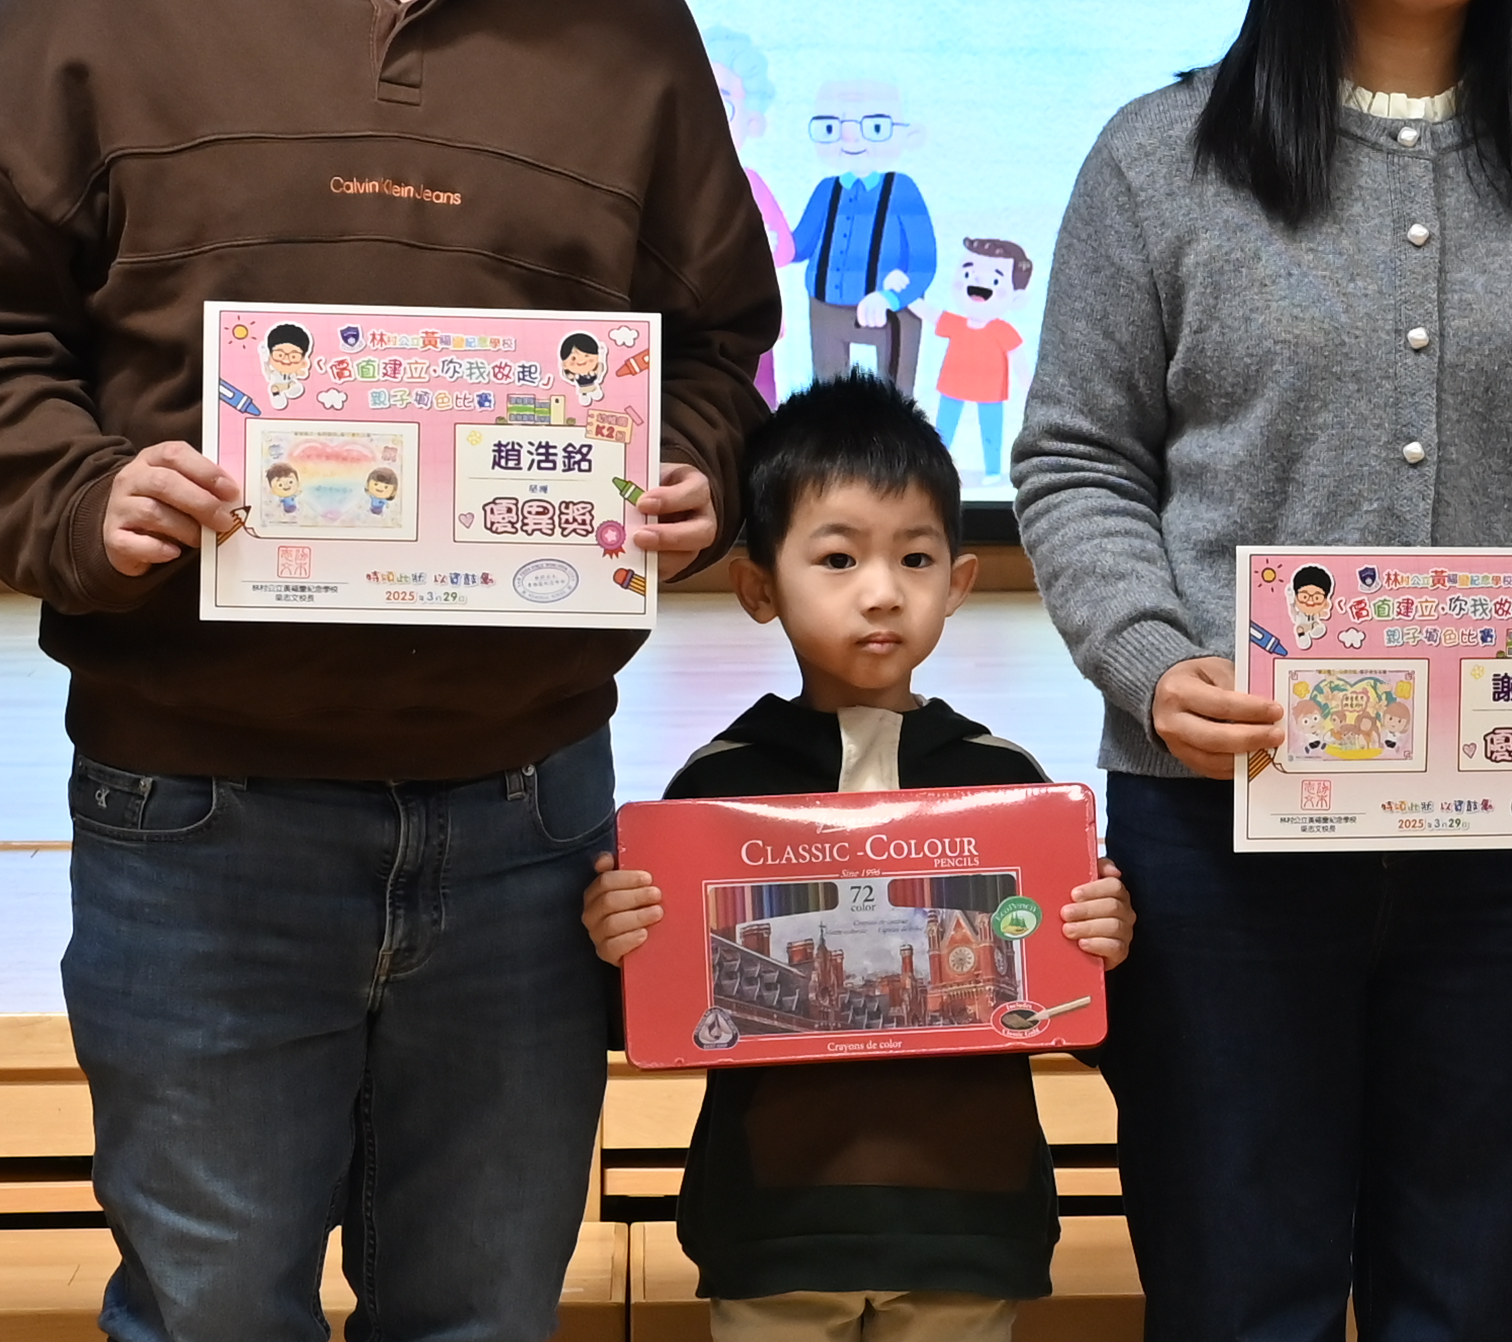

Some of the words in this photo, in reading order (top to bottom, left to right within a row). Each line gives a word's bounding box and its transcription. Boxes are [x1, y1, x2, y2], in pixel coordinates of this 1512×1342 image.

[330, 176, 378, 194] Calvin
[379, 177, 414, 198] Klein
[415, 183, 461, 205] Jeans
[491, 440, 593, 473] 趙浩銘
[483, 497, 595, 537] 優異獎
[741, 839, 850, 866] CLASSIC
[933, 856, 980, 868] PENCILS
[849, 885, 875, 903] 72
[850, 902, 877, 913] color
[827, 1042, 864, 1053] Crayons
[866, 1041, 878, 1049] de
[879, 1040, 903, 1049] color
